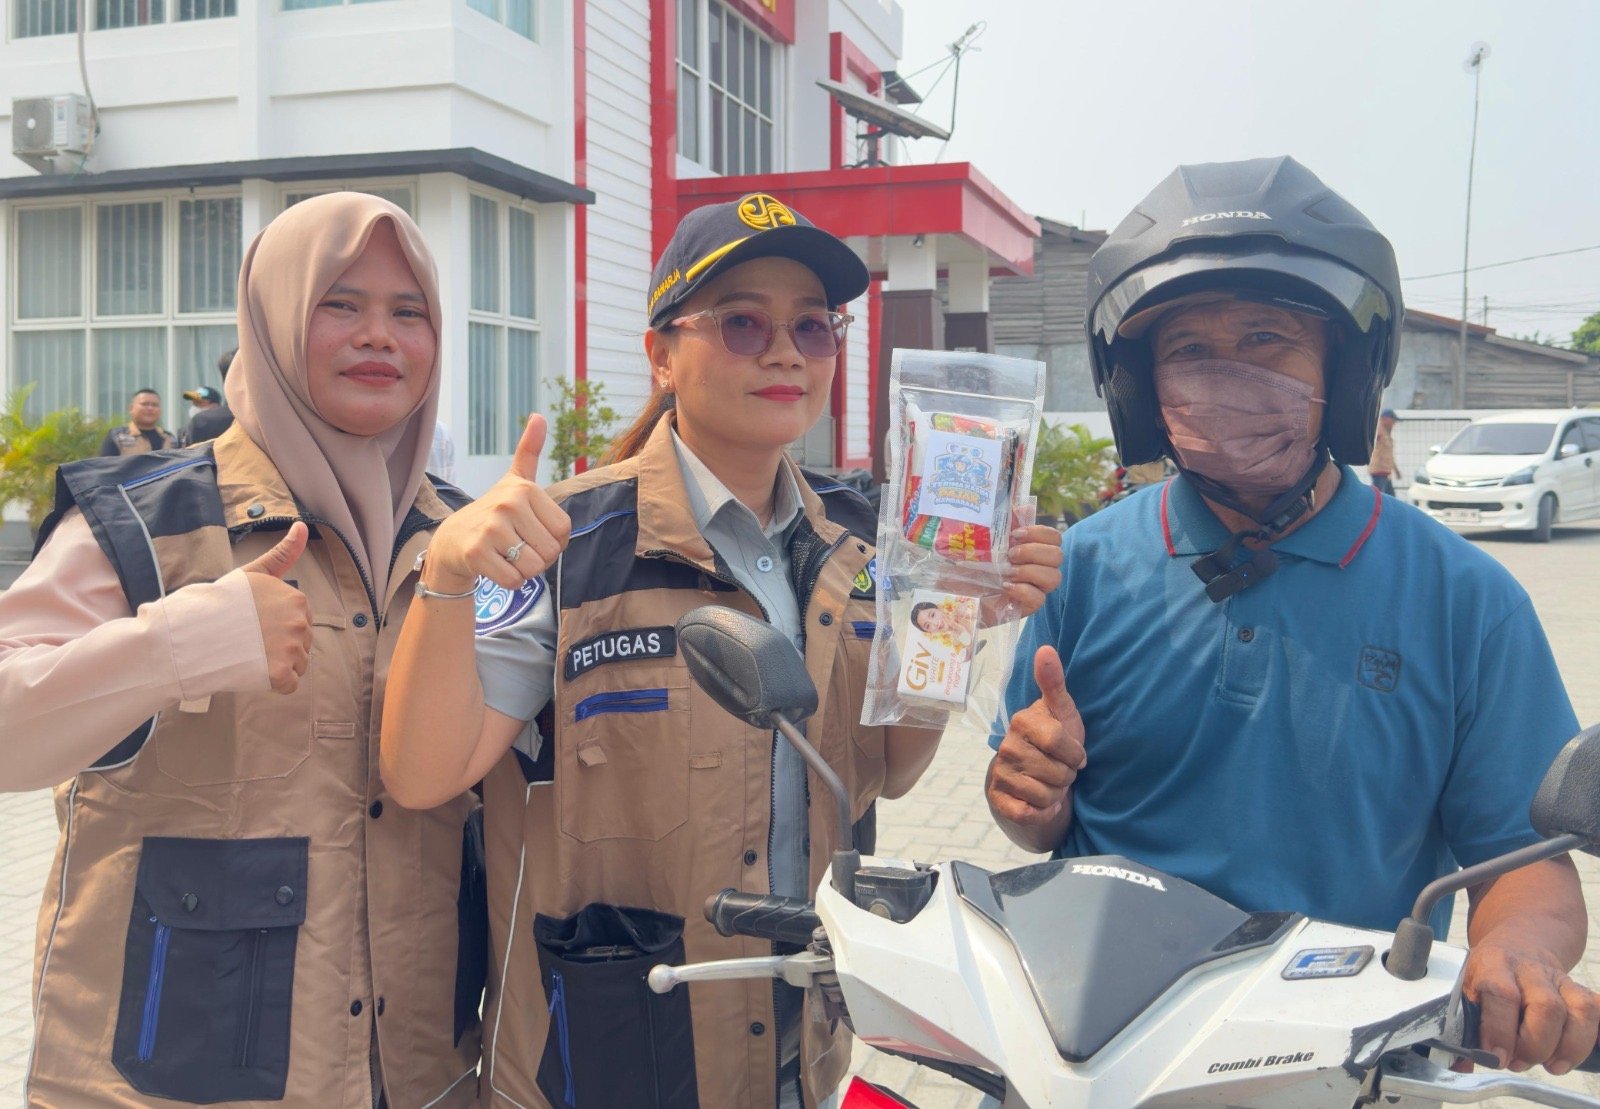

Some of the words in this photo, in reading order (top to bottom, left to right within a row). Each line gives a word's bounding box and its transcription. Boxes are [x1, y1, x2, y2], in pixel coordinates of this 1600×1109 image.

[1181, 211, 1272, 228] HONDA
[573, 633, 661, 671] PETUGAS
[929, 656, 938, 683] WHITE
[1071, 864, 1168, 892] HONDA
[1207, 1057, 1262, 1074] Combi
[1264, 1051, 1314, 1067] Brake
